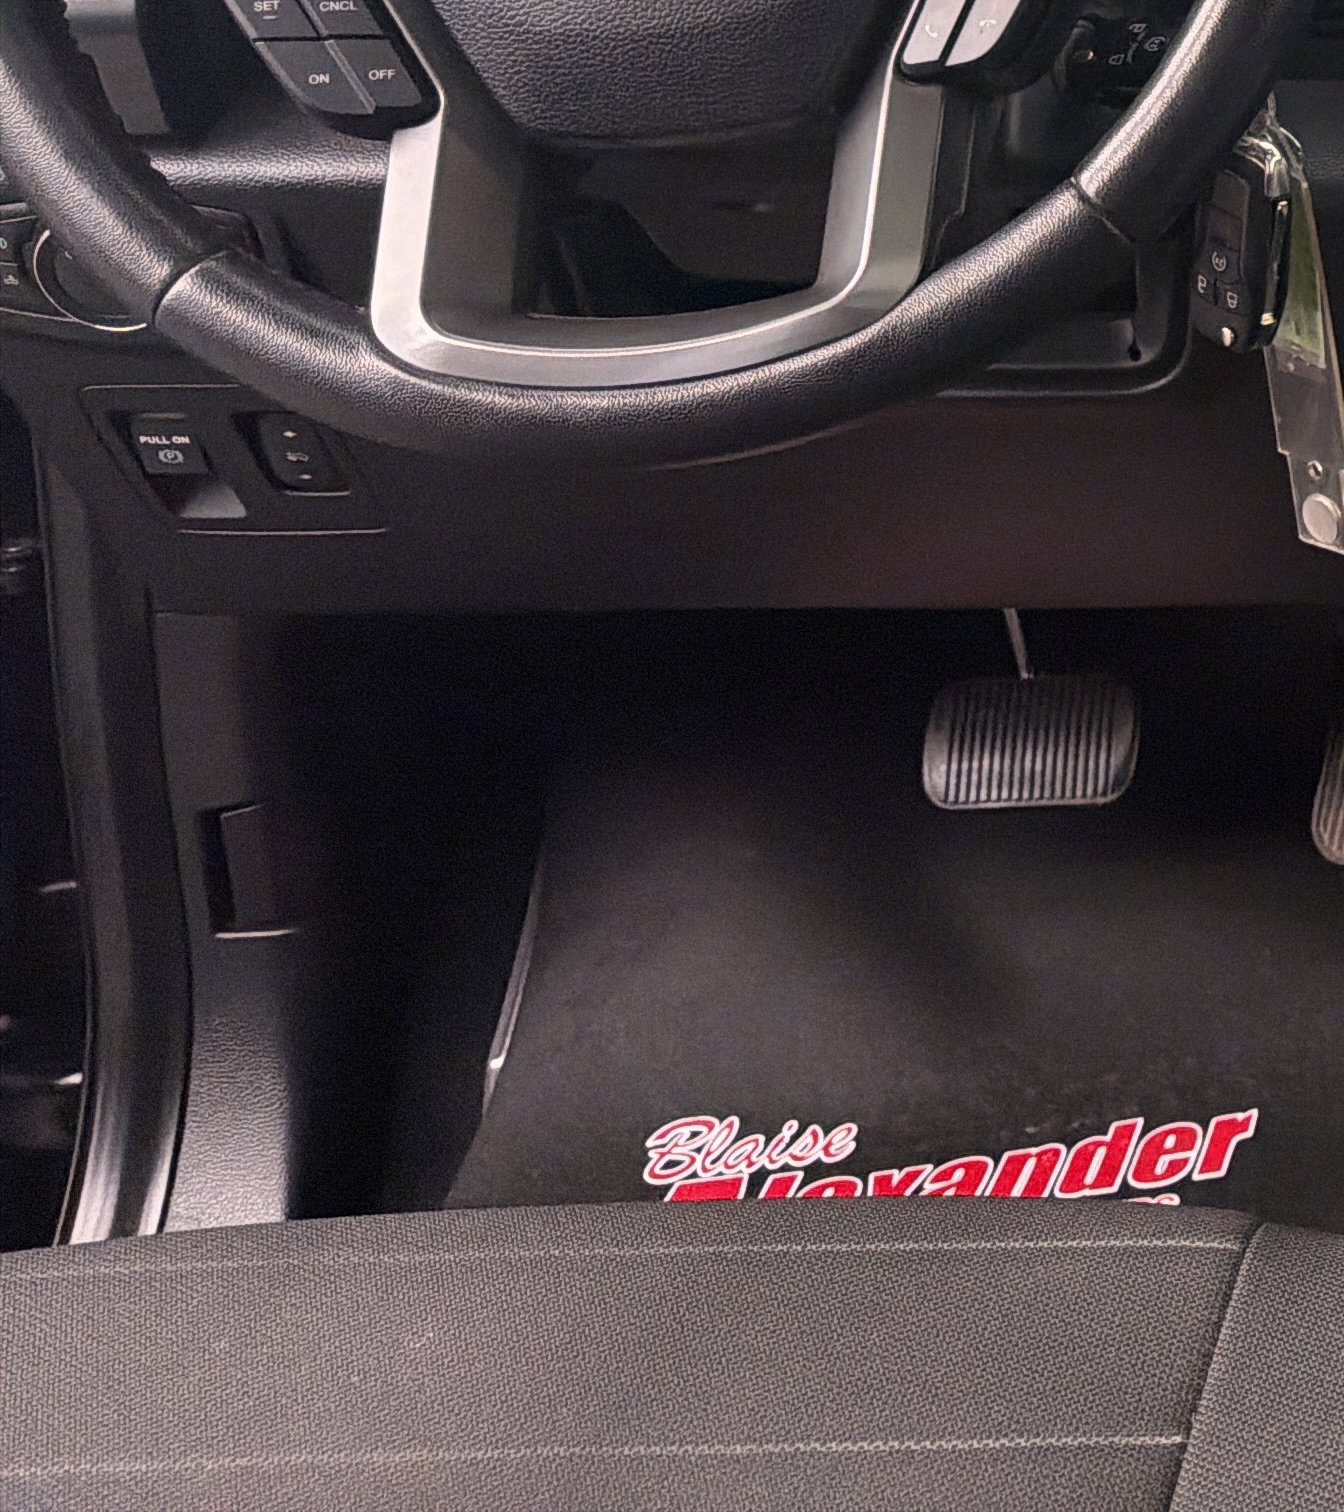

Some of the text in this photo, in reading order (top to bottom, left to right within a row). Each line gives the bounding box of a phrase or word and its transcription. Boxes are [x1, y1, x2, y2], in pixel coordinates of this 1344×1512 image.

[253, 0, 280, 12] SET
[319, 0, 358, 12] CNCL
[308, 73, 330, 85] ON
[368, 69, 396, 80] OFF
[139, 435, 190, 445] PULL ON
[642, 1114, 858, 1186] Blaise
